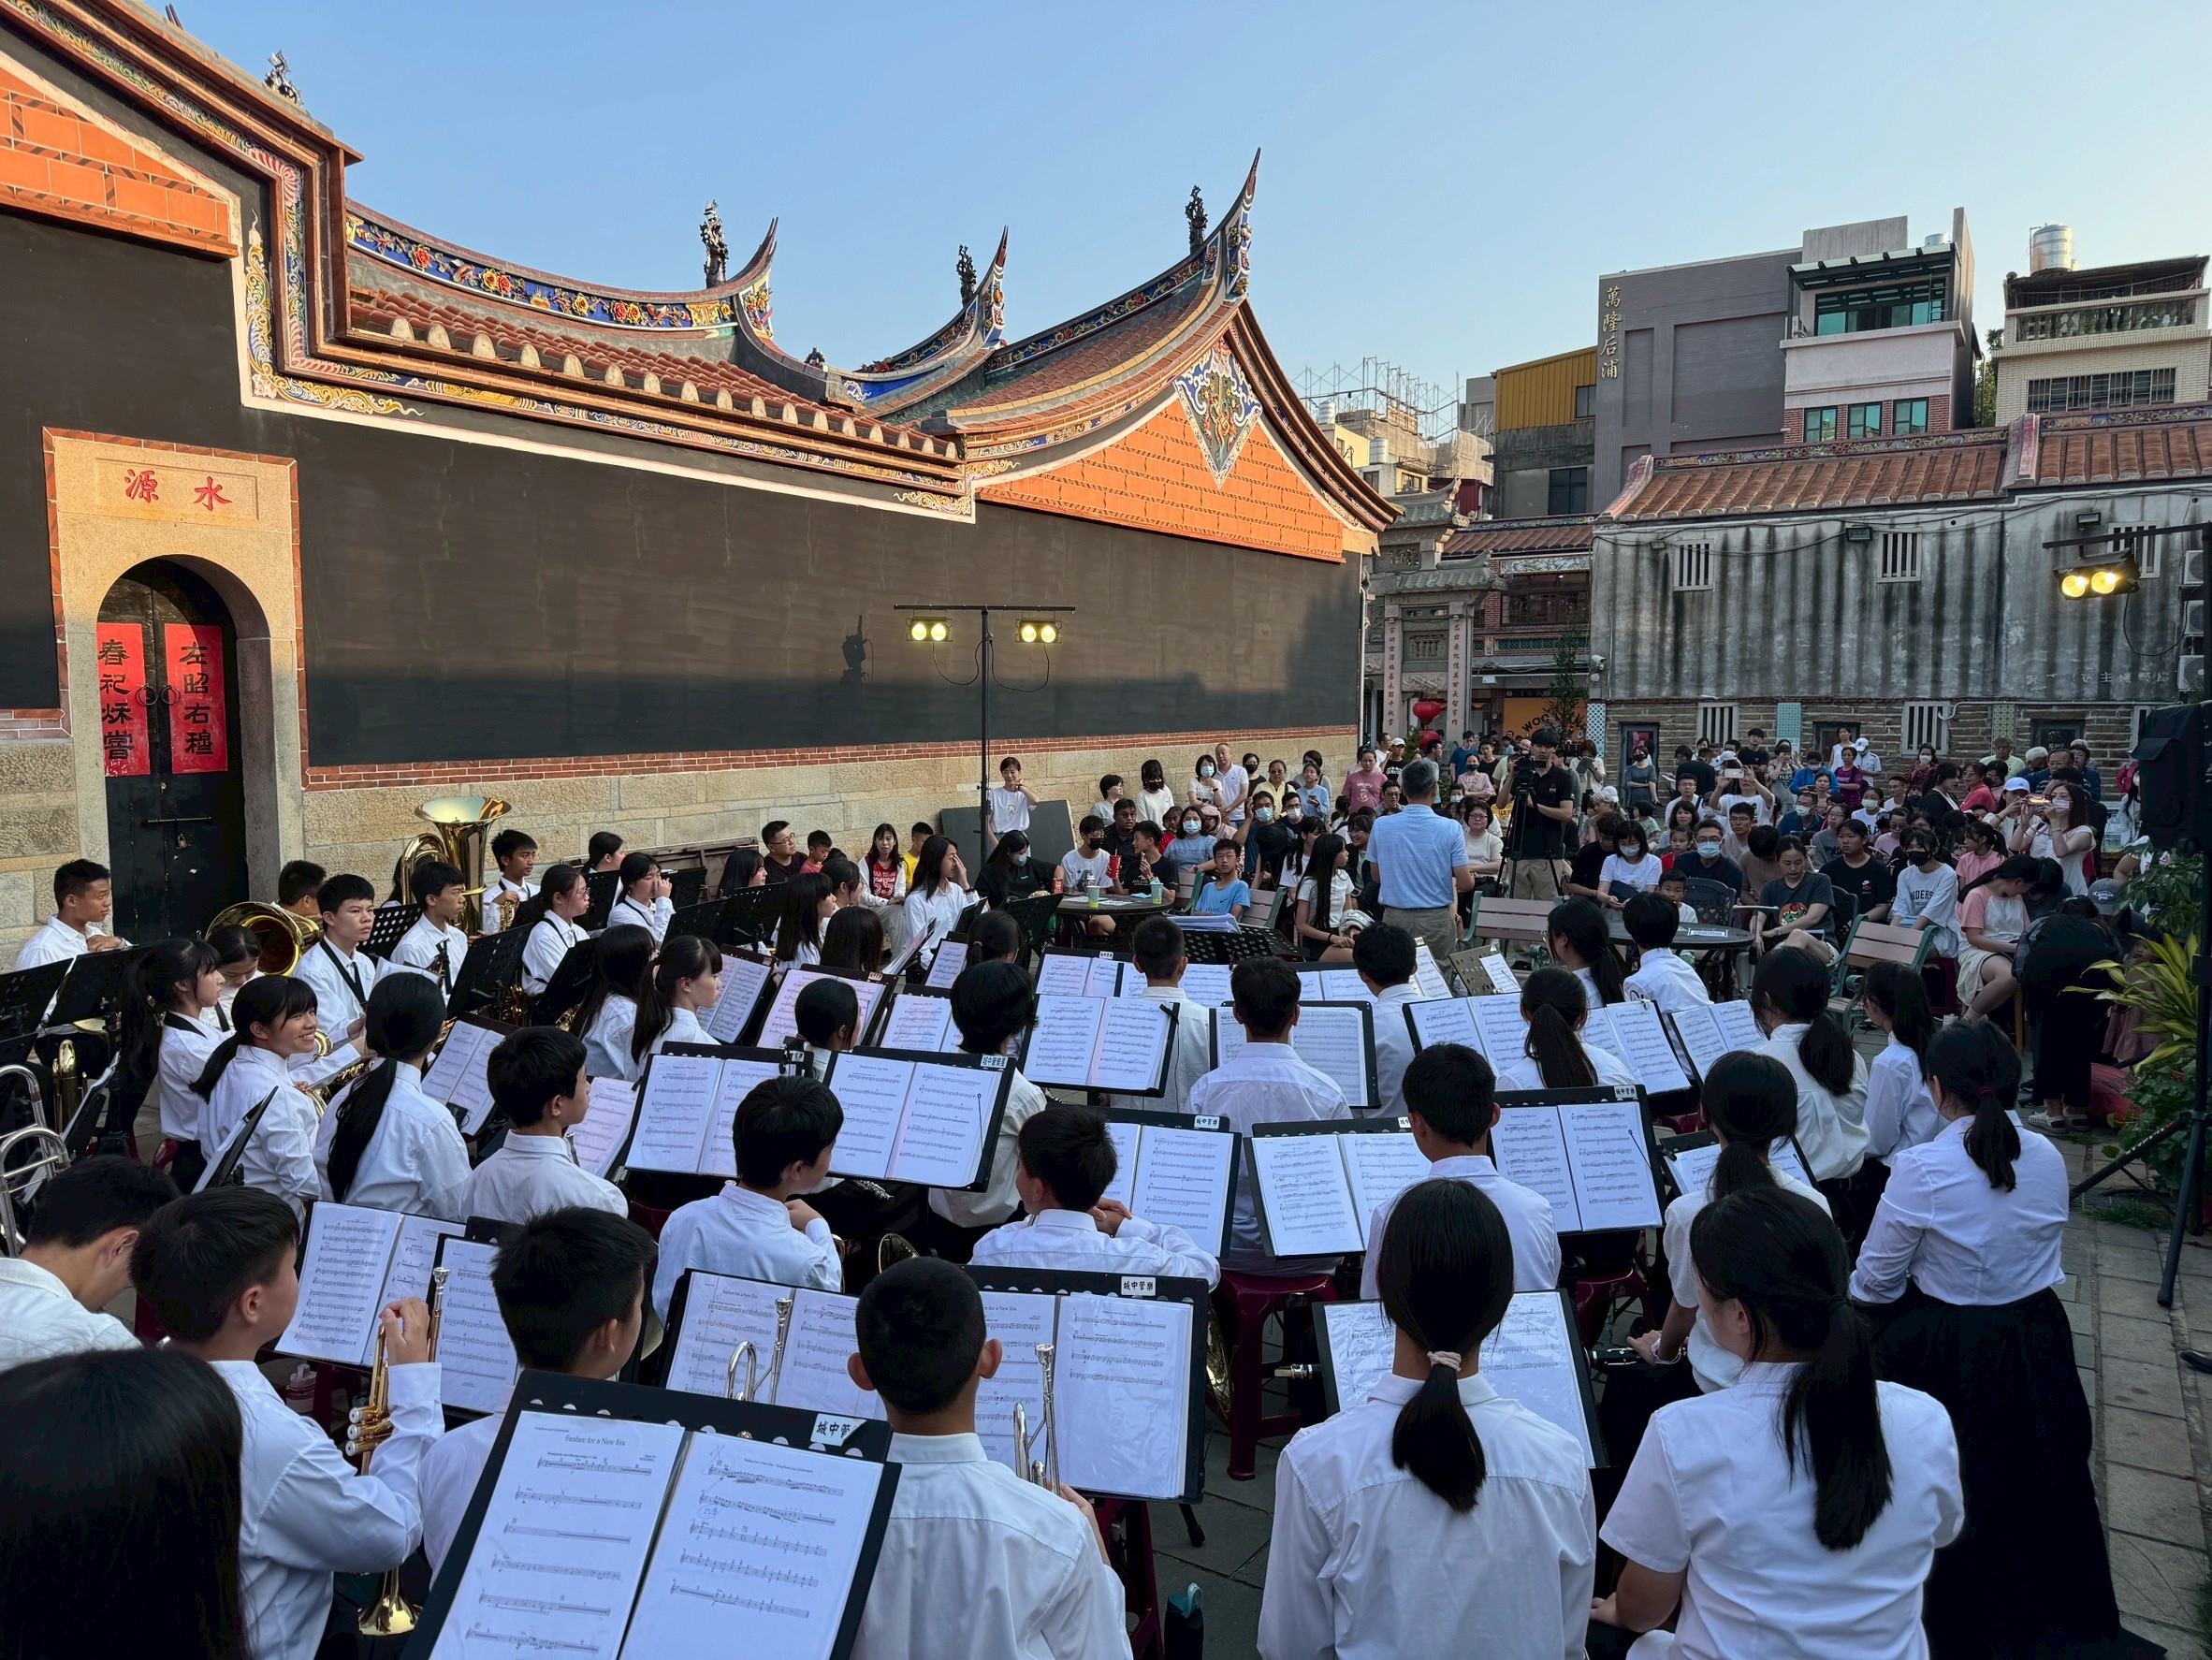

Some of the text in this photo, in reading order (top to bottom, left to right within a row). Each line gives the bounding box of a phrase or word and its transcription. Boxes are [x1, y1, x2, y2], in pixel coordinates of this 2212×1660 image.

[1600, 285, 1623, 380] 萬隆后浦
[179, 642, 214, 756] 左昭右穆
[1123, 1280, 1154, 1291] 城中管樂
[817, 1420, 856, 1439] 城中管
[564, 1434, 587, 1444] Fanfare
[601, 1437, 615, 1446] New
[615, 1438, 626, 1447] Era
